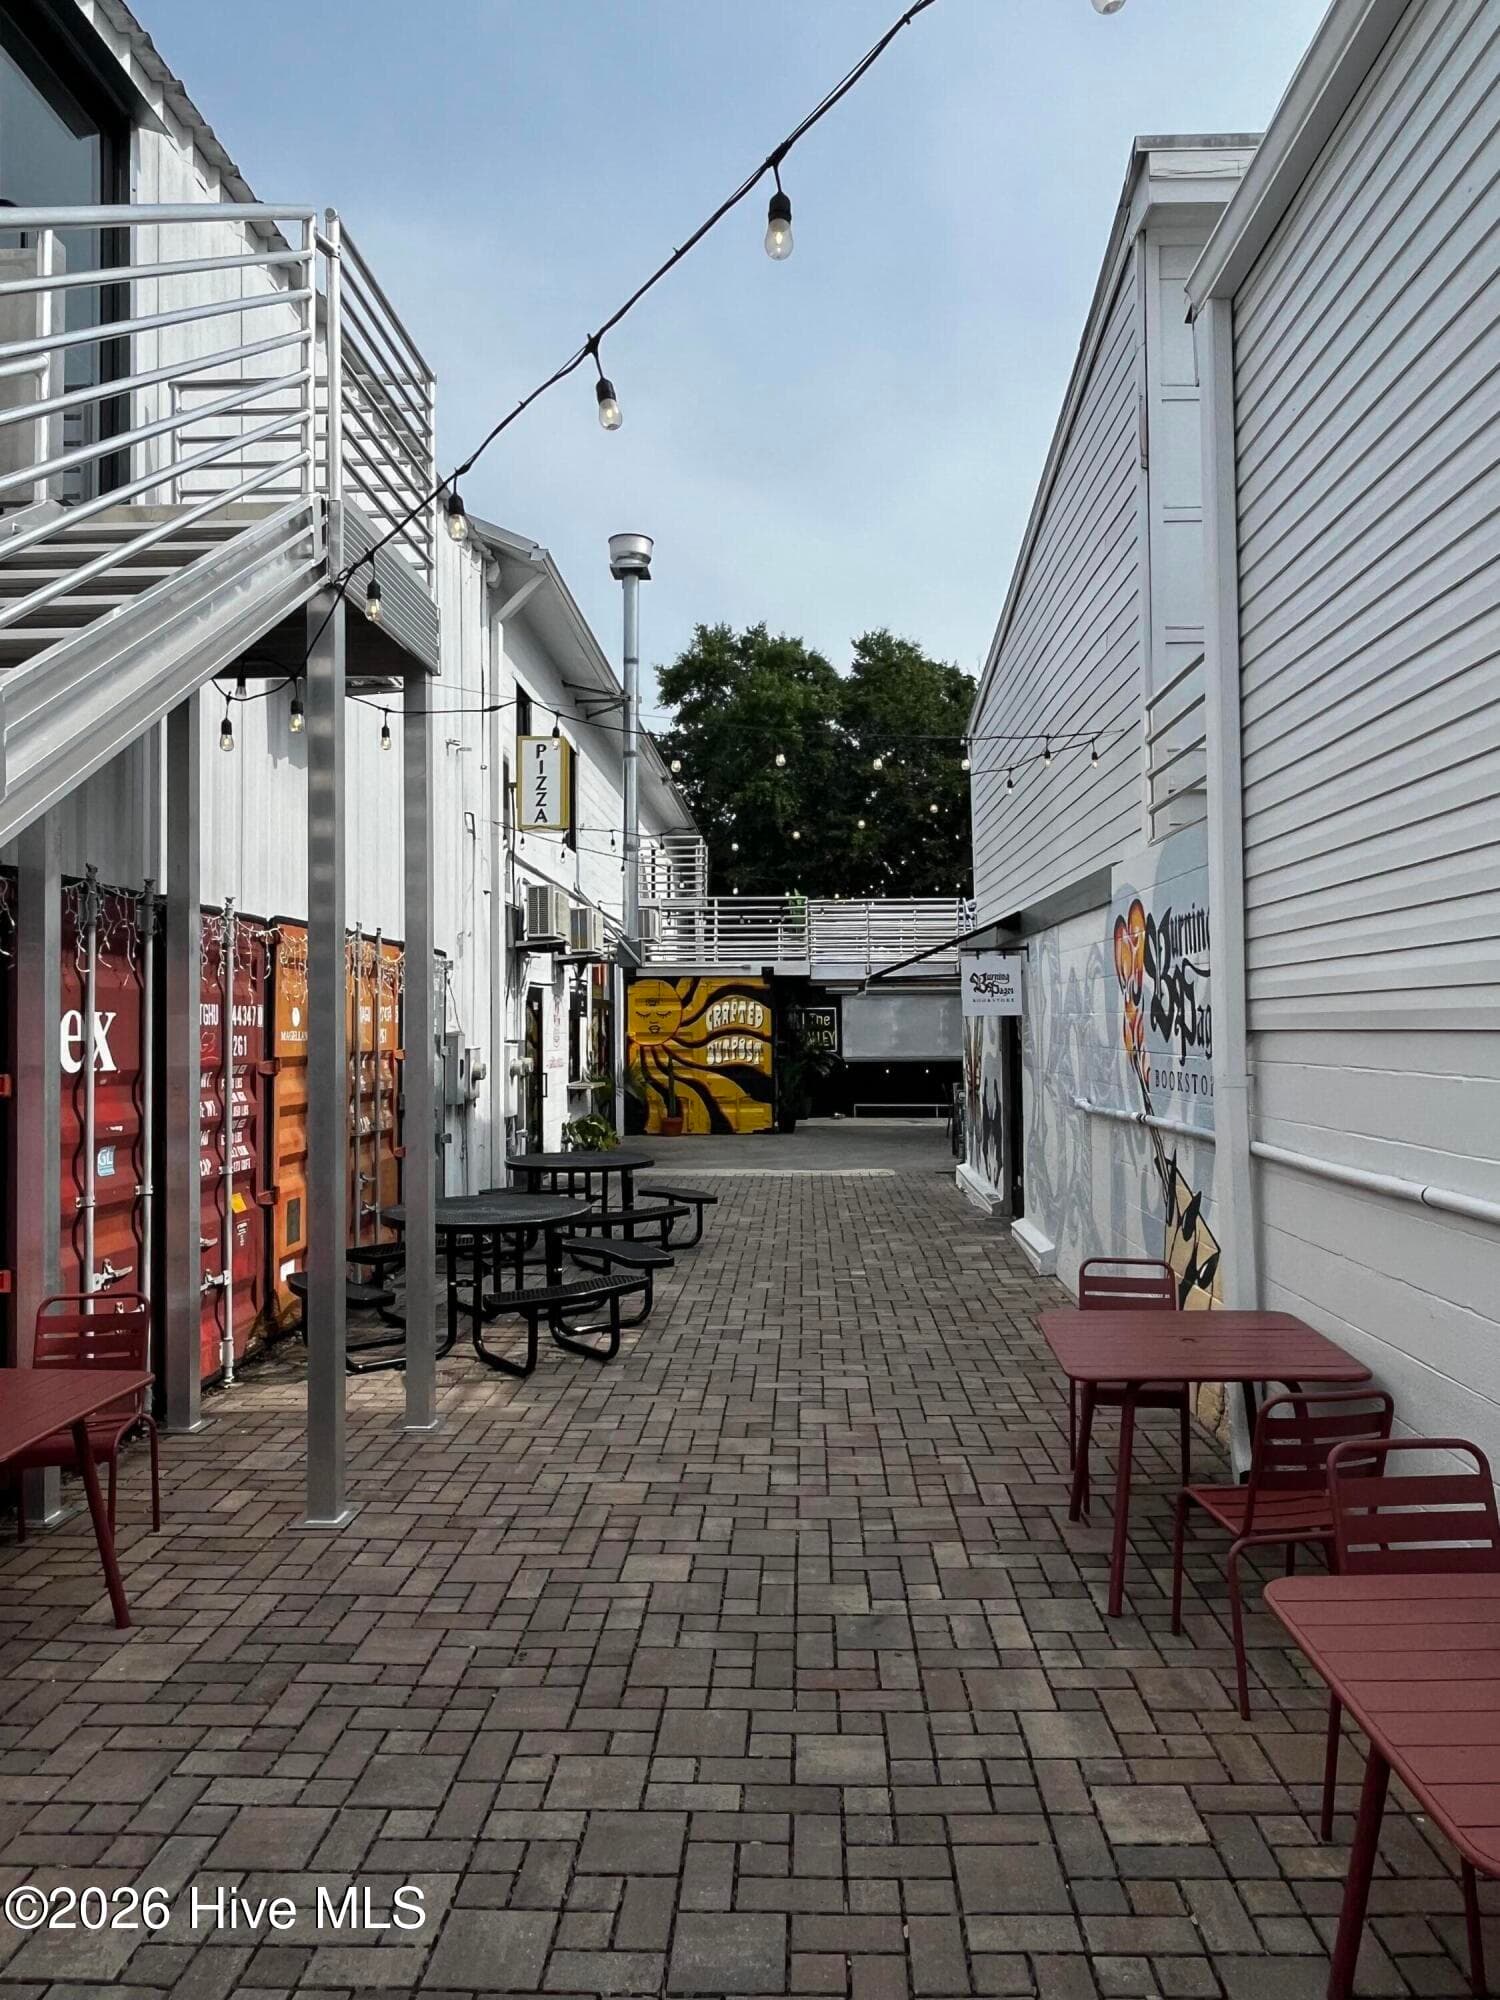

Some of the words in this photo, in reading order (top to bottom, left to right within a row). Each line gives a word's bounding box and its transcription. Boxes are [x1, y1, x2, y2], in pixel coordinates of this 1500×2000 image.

[534, 743, 548, 823] PIZZA
[705, 998, 763, 1031] CRAFTED
[706, 1036, 764, 1066] OUTPOST
